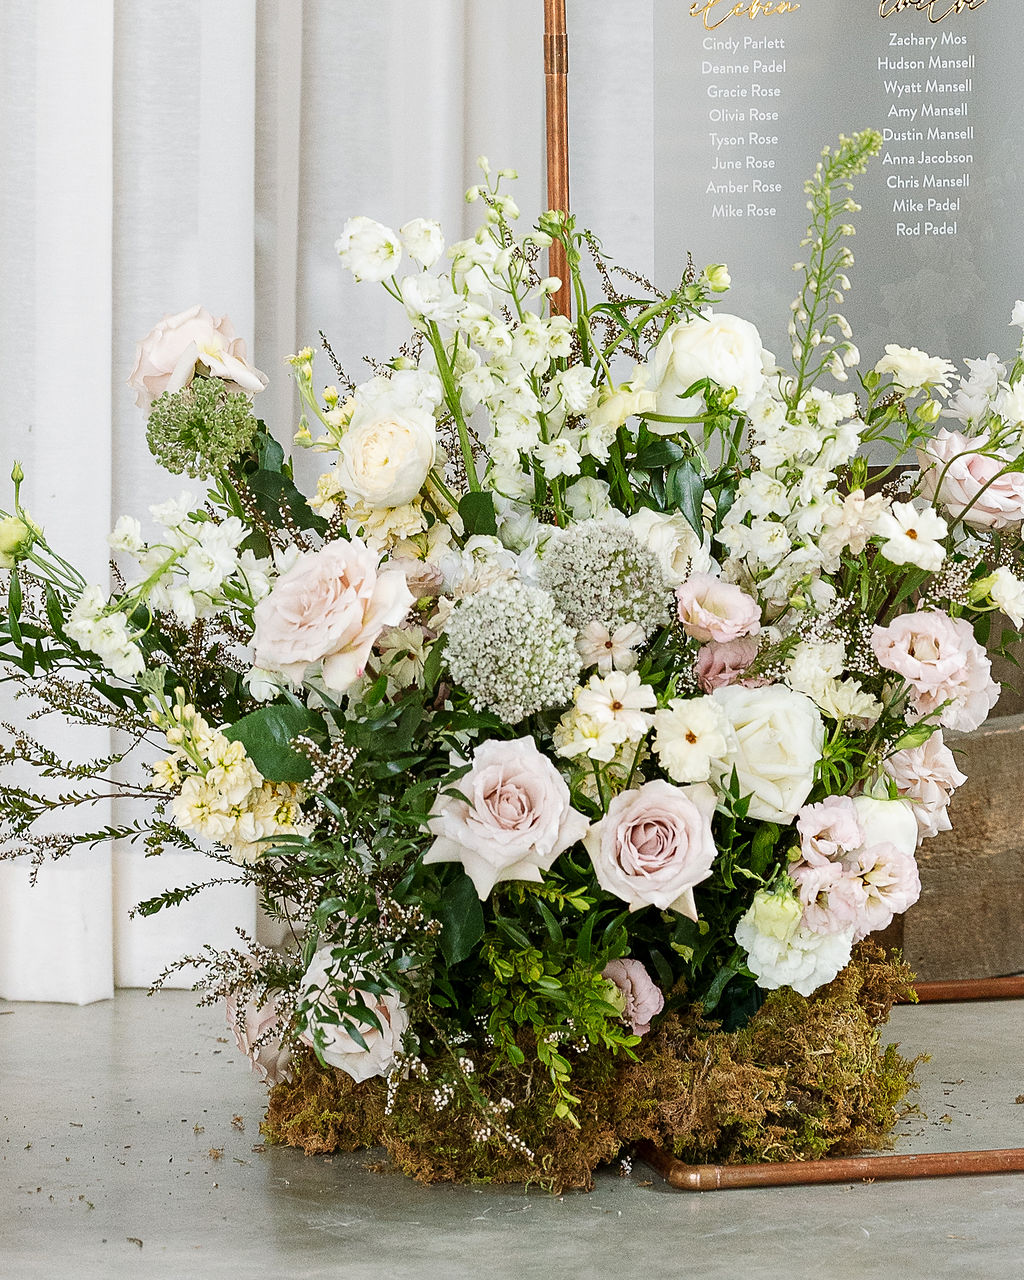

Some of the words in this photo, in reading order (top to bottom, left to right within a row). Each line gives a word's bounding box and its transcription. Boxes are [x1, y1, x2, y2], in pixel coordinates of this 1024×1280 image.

[702, 36, 740, 55] Cindy
[743, 36, 786, 50] Parlett
[888, 32, 938, 50] Zachary
[940, 31, 967, 45] Mos
[701, 60, 750, 75] Deanne
[753, 59, 787, 74] Padel
[877, 56, 925, 71] Hudson
[928, 54, 975, 69] Mansell
[706, 84, 748, 98] Gracie
[751, 83, 781, 97] Rose
[883, 80, 922, 98] Wyatt
[925, 78, 972, 93] Mansell
[708, 132, 745, 151] Tyson
[748, 131, 779, 145] Rose
[882, 152, 915, 166] Anna
[917, 150, 974, 165] Jacobson
[705, 180, 749, 194] Amber
[752, 179, 783, 193] Rose
[886, 175, 920, 189] Chris
[922, 173, 970, 188] Mansell
[892, 198, 924, 213] Mike
[927, 197, 960, 212] Padel
